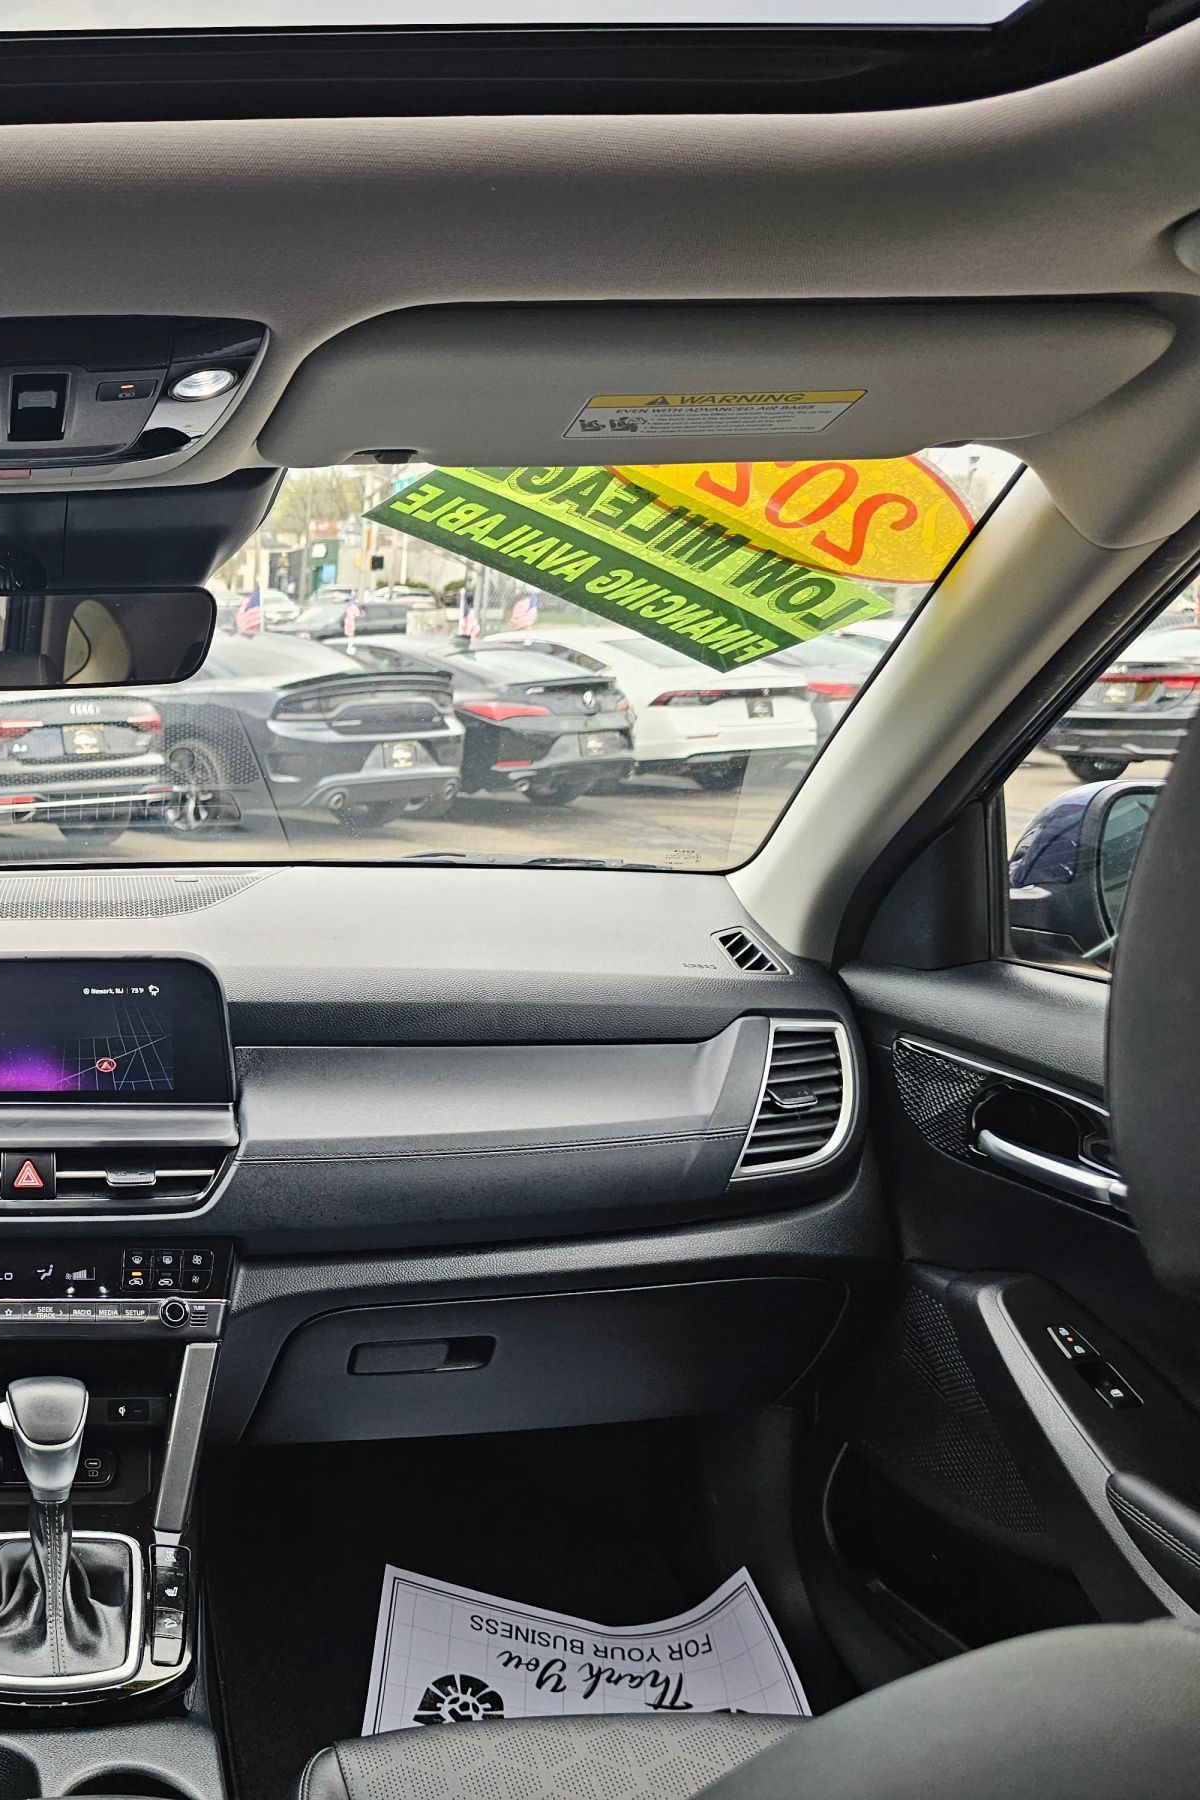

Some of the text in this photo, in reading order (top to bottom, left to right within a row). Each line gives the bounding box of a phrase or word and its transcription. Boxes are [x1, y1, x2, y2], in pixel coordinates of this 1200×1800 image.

[678, 393, 805, 405] WARNING
[470, 1614, 713, 1662] FOR YOUR BUSINESS
[578, 1662, 693, 1710] Thank
